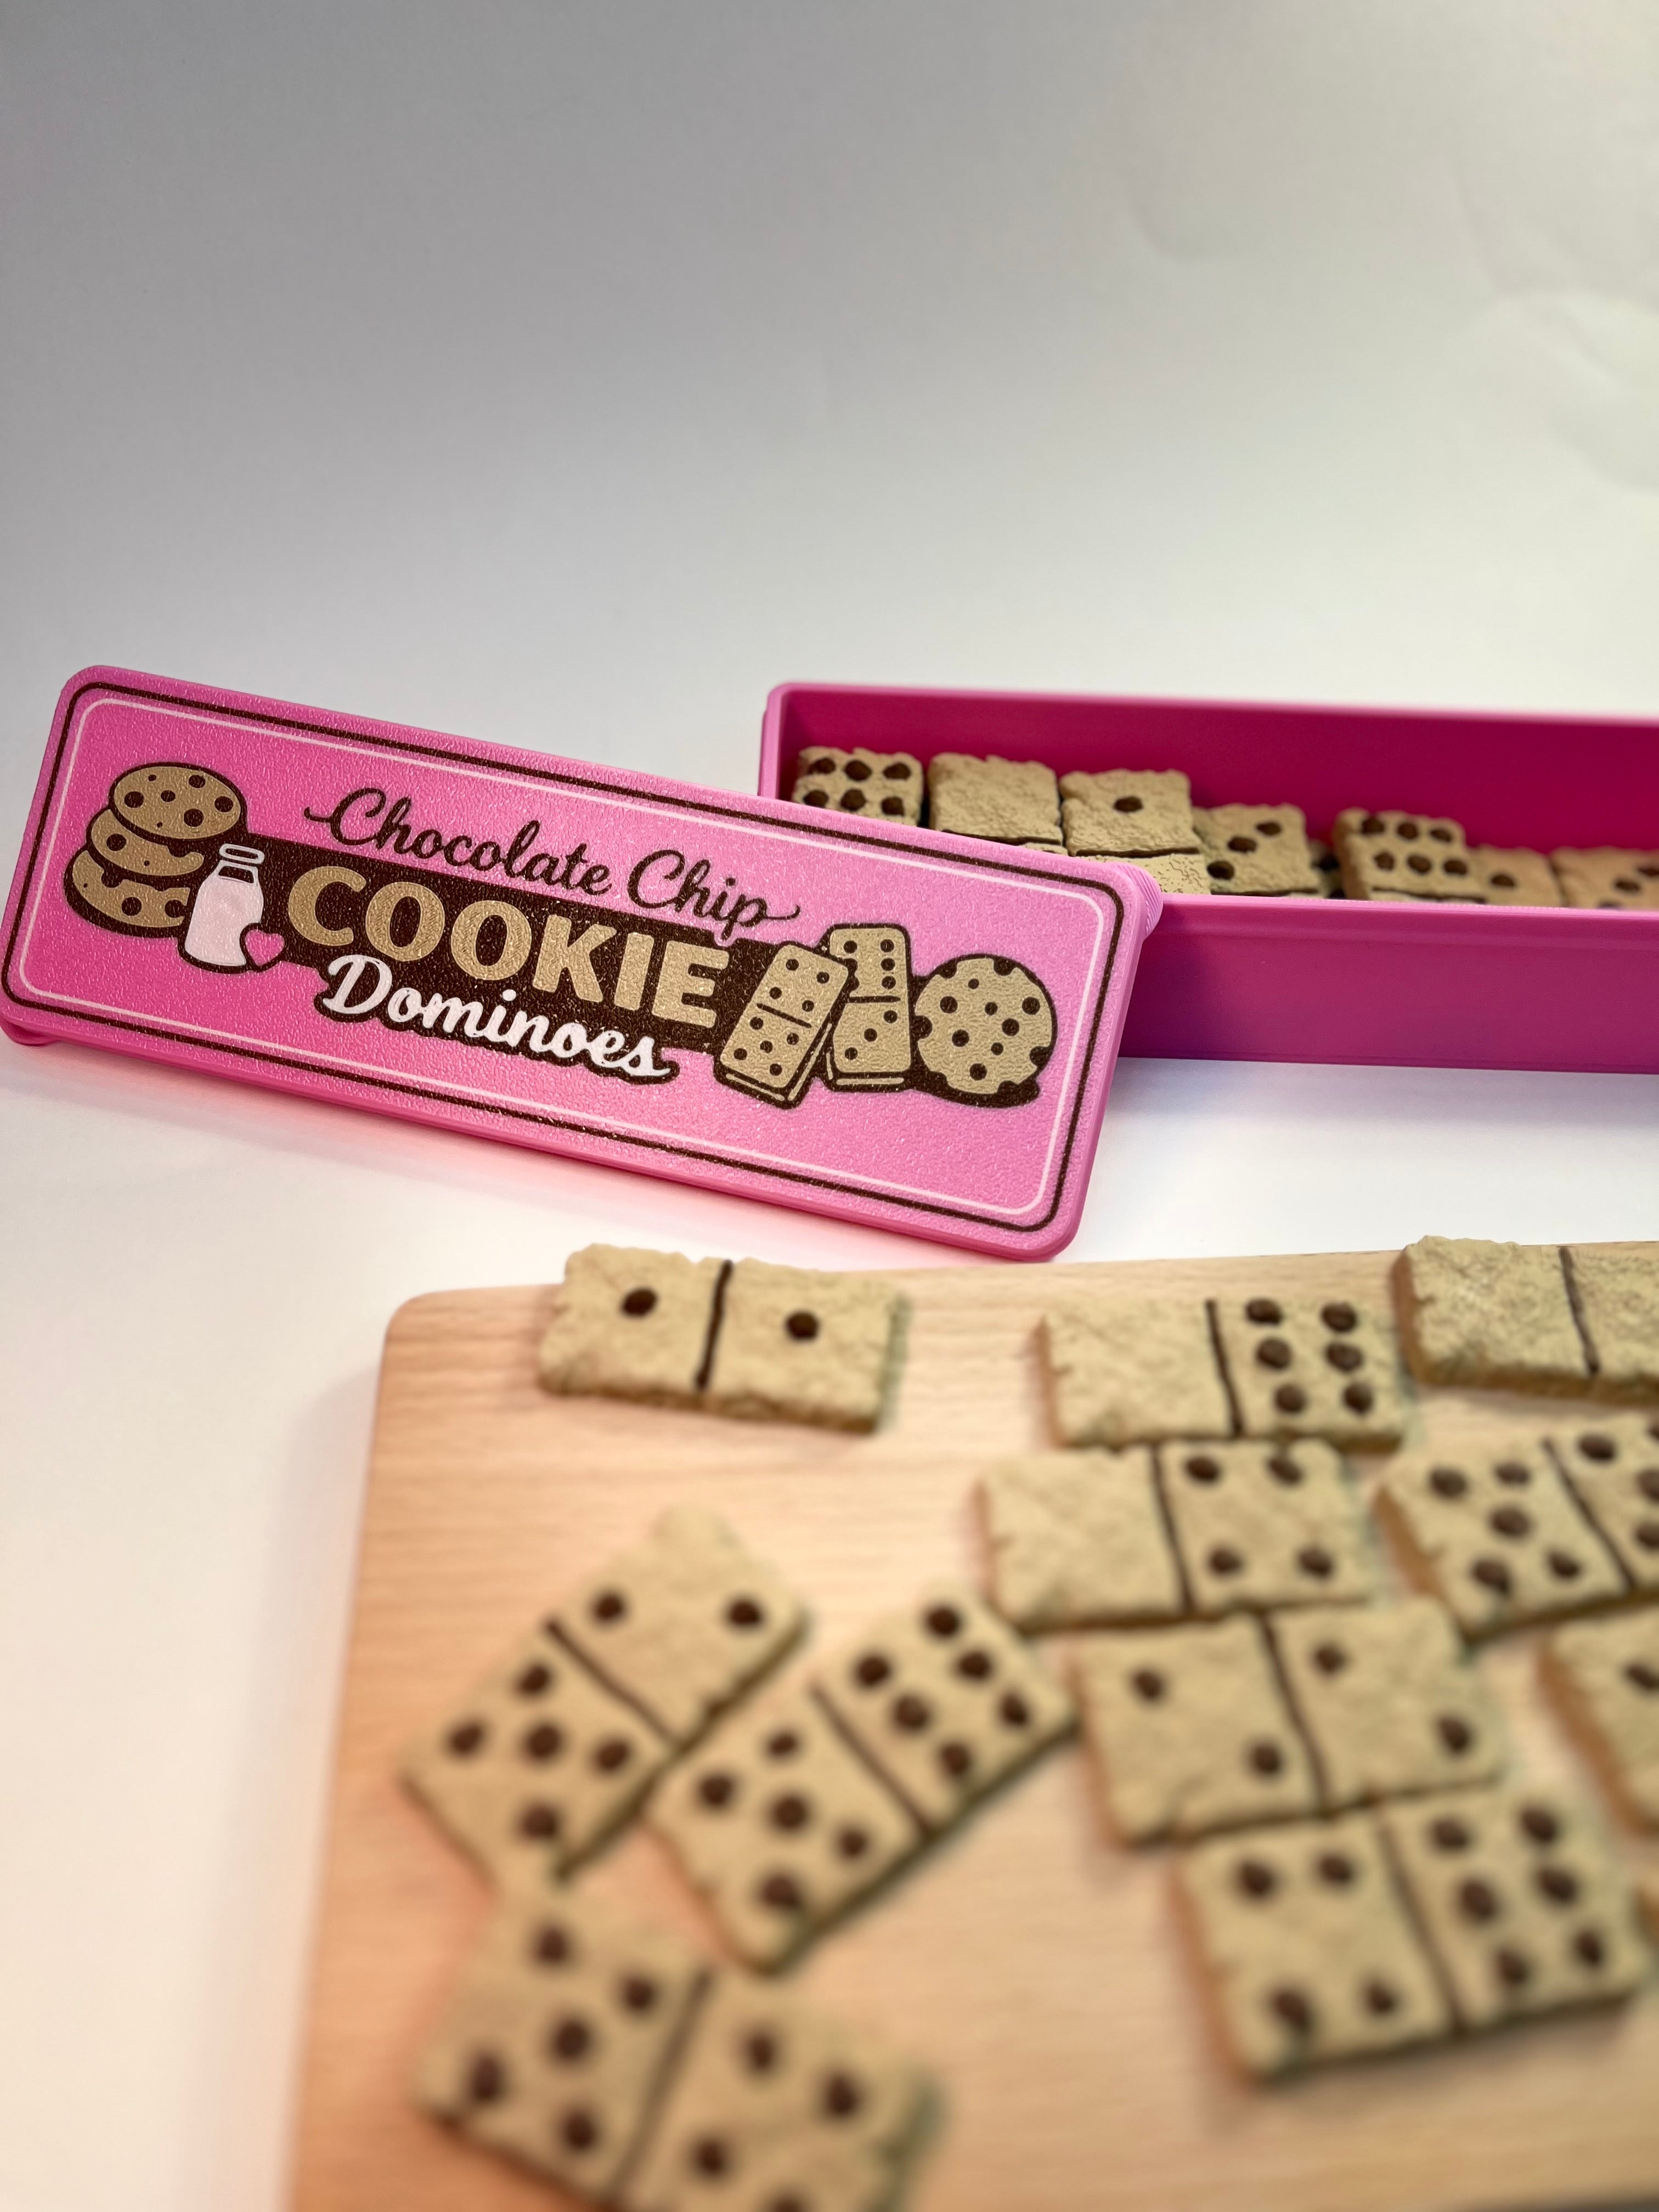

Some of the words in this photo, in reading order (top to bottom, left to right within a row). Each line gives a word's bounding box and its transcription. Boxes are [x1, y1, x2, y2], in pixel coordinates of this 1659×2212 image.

[304, 788, 612, 896] Chocolate
[628, 849, 801, 940] Chip
[287, 865, 730, 1028] COOKIE
[322, 954, 672, 1079] Dominoes
